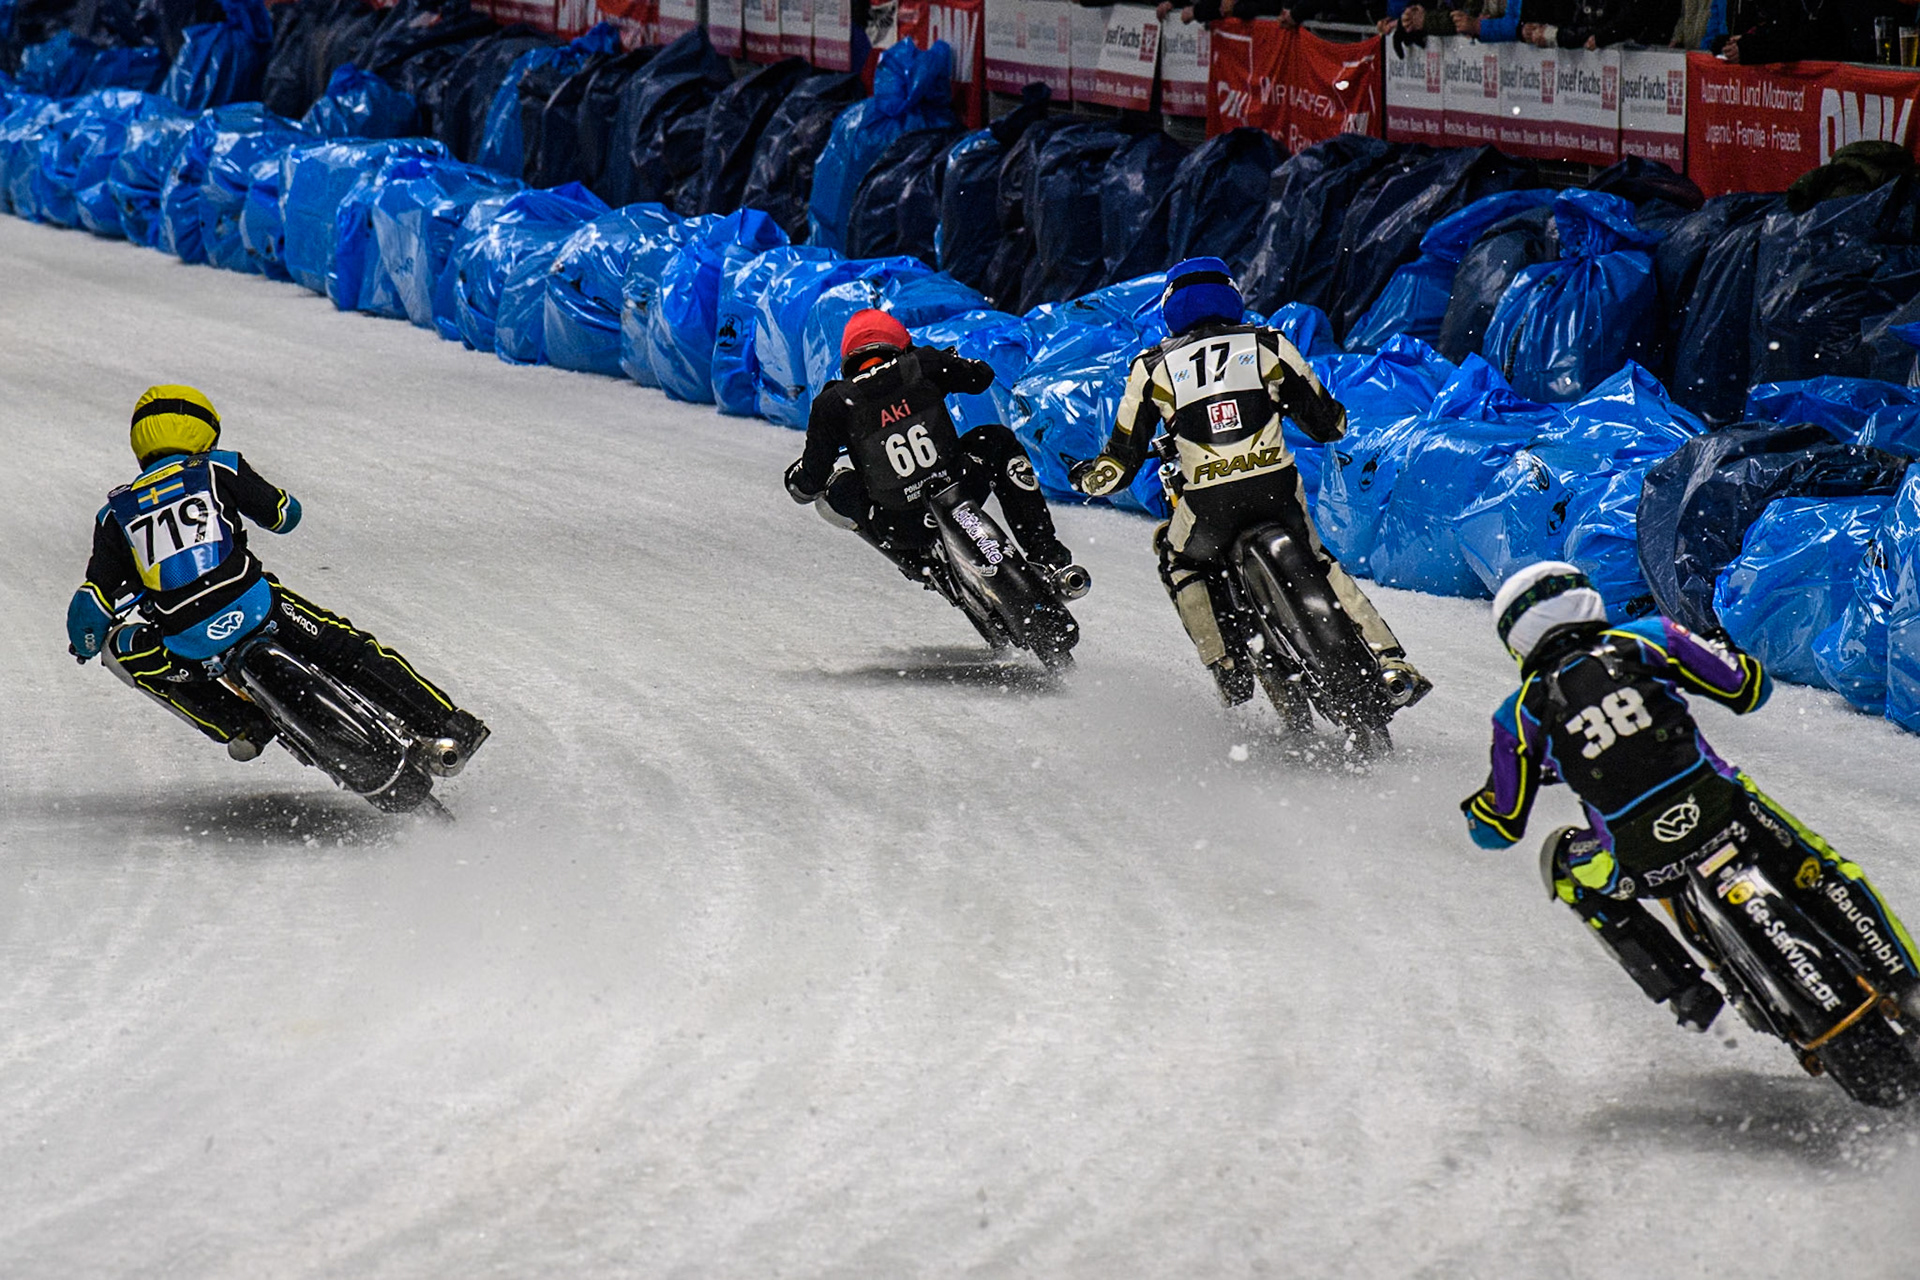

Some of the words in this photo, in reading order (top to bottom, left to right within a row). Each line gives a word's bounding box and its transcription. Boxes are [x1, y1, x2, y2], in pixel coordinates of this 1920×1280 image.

[1579, 70, 1600, 95] Fuchs
[1643, 76, 1665, 101] Fuchs
[1743, 80, 1761, 108] und
[1762, 81, 1806, 112] Motorrad
[1736, 120, 1766, 148] Familie
[1771, 123, 1801, 152] Freizeit
[1189, 341, 1230, 389] 17
[880, 398, 912, 428] Aki
[885, 424, 938, 478] 66
[1193, 446, 1283, 485] FRANZ
[130, 497, 209, 567] 719
[291, 611, 319, 636] WACO
[1565, 686, 1653, 760] 38
